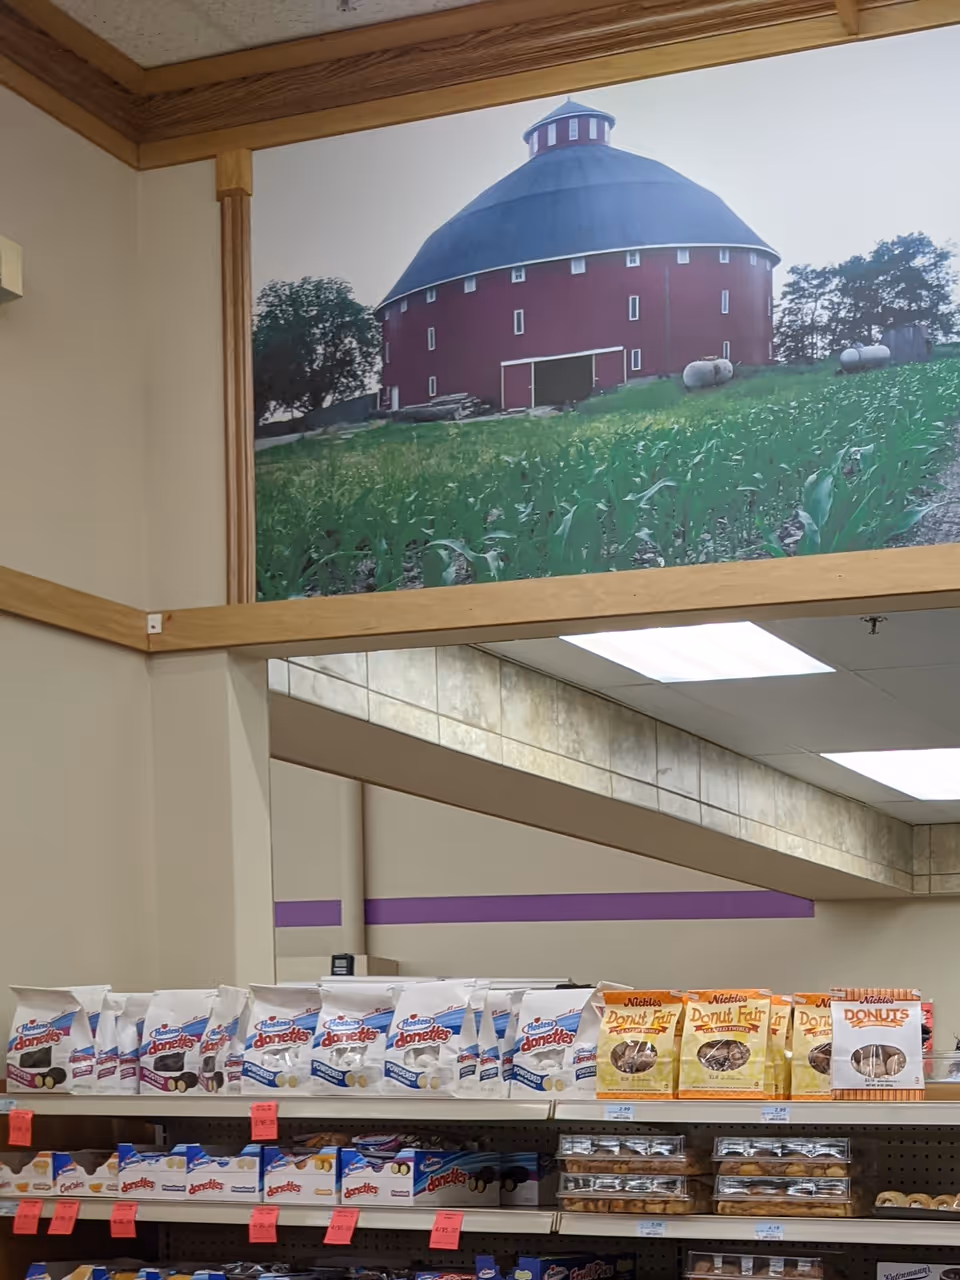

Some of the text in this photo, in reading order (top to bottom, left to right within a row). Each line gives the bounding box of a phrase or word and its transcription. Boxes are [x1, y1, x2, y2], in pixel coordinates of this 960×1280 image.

[624, 998, 662, 1008] Nickles
[709, 994, 747, 1005] Nickles
[605, 1010, 677, 1026] Donut Fair
[689, 1006, 766, 1024] Donut Fair
[844, 1008, 909, 1021] DONUTS
[328, 1017, 362, 1030] Hostess
[401, 1017, 433, 1030] Hostess
[525, 1021, 555, 1034] Hostess
[14, 1030, 64, 1051] donettes
[149, 1036, 201, 1055] donettes
[253, 1030, 311, 1049] donettes
[321, 1028, 380, 1048] donettes
[395, 1028, 451, 1048] donettes
[521, 1033, 575, 1052] donettes
[121, 1177, 155, 1193] donettes
[189, 1179, 224, 1194] donettes
[266, 1183, 302, 1197] donettes
[344, 1184, 379, 1199] donettes
